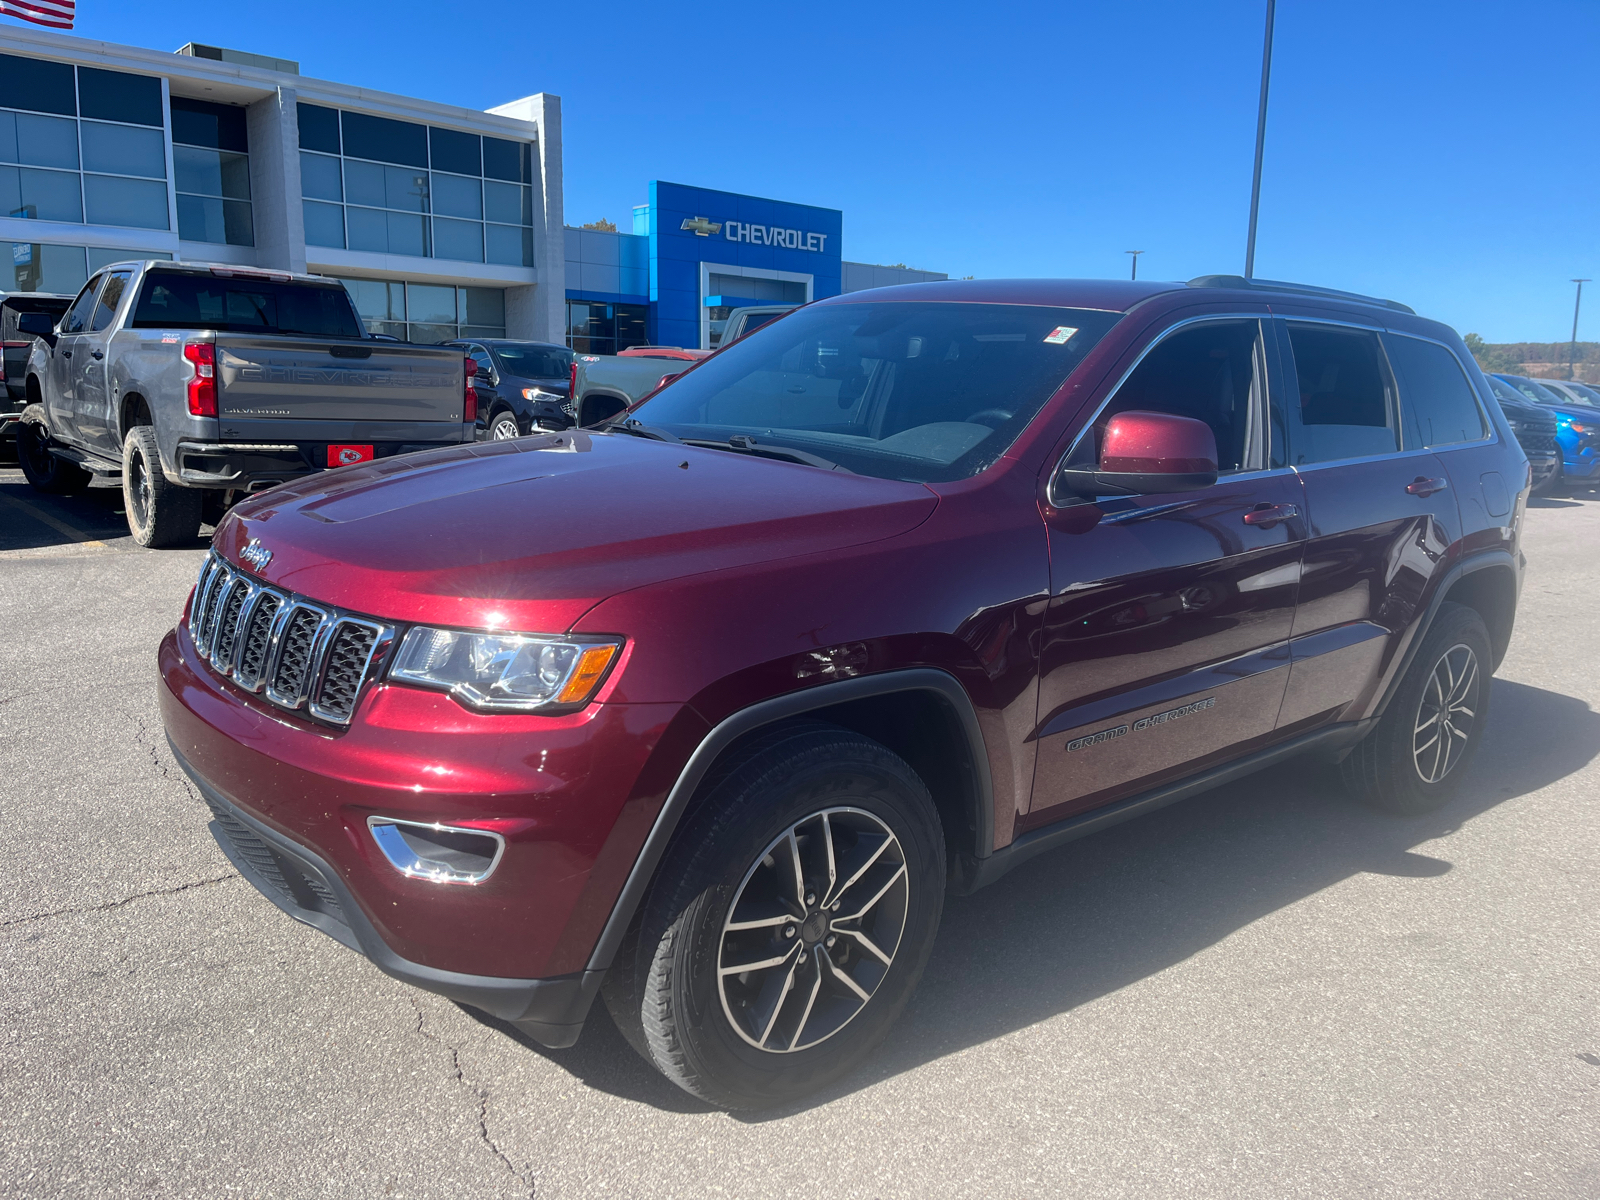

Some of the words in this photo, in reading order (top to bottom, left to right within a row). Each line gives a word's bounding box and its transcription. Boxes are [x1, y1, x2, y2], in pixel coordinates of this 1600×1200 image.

[725, 220, 827, 252] CHEVROLET
[239, 538, 273, 573] Jeep
[1066, 725, 1130, 753] GRAND
[1132, 697, 1217, 732] CHEROKEE
